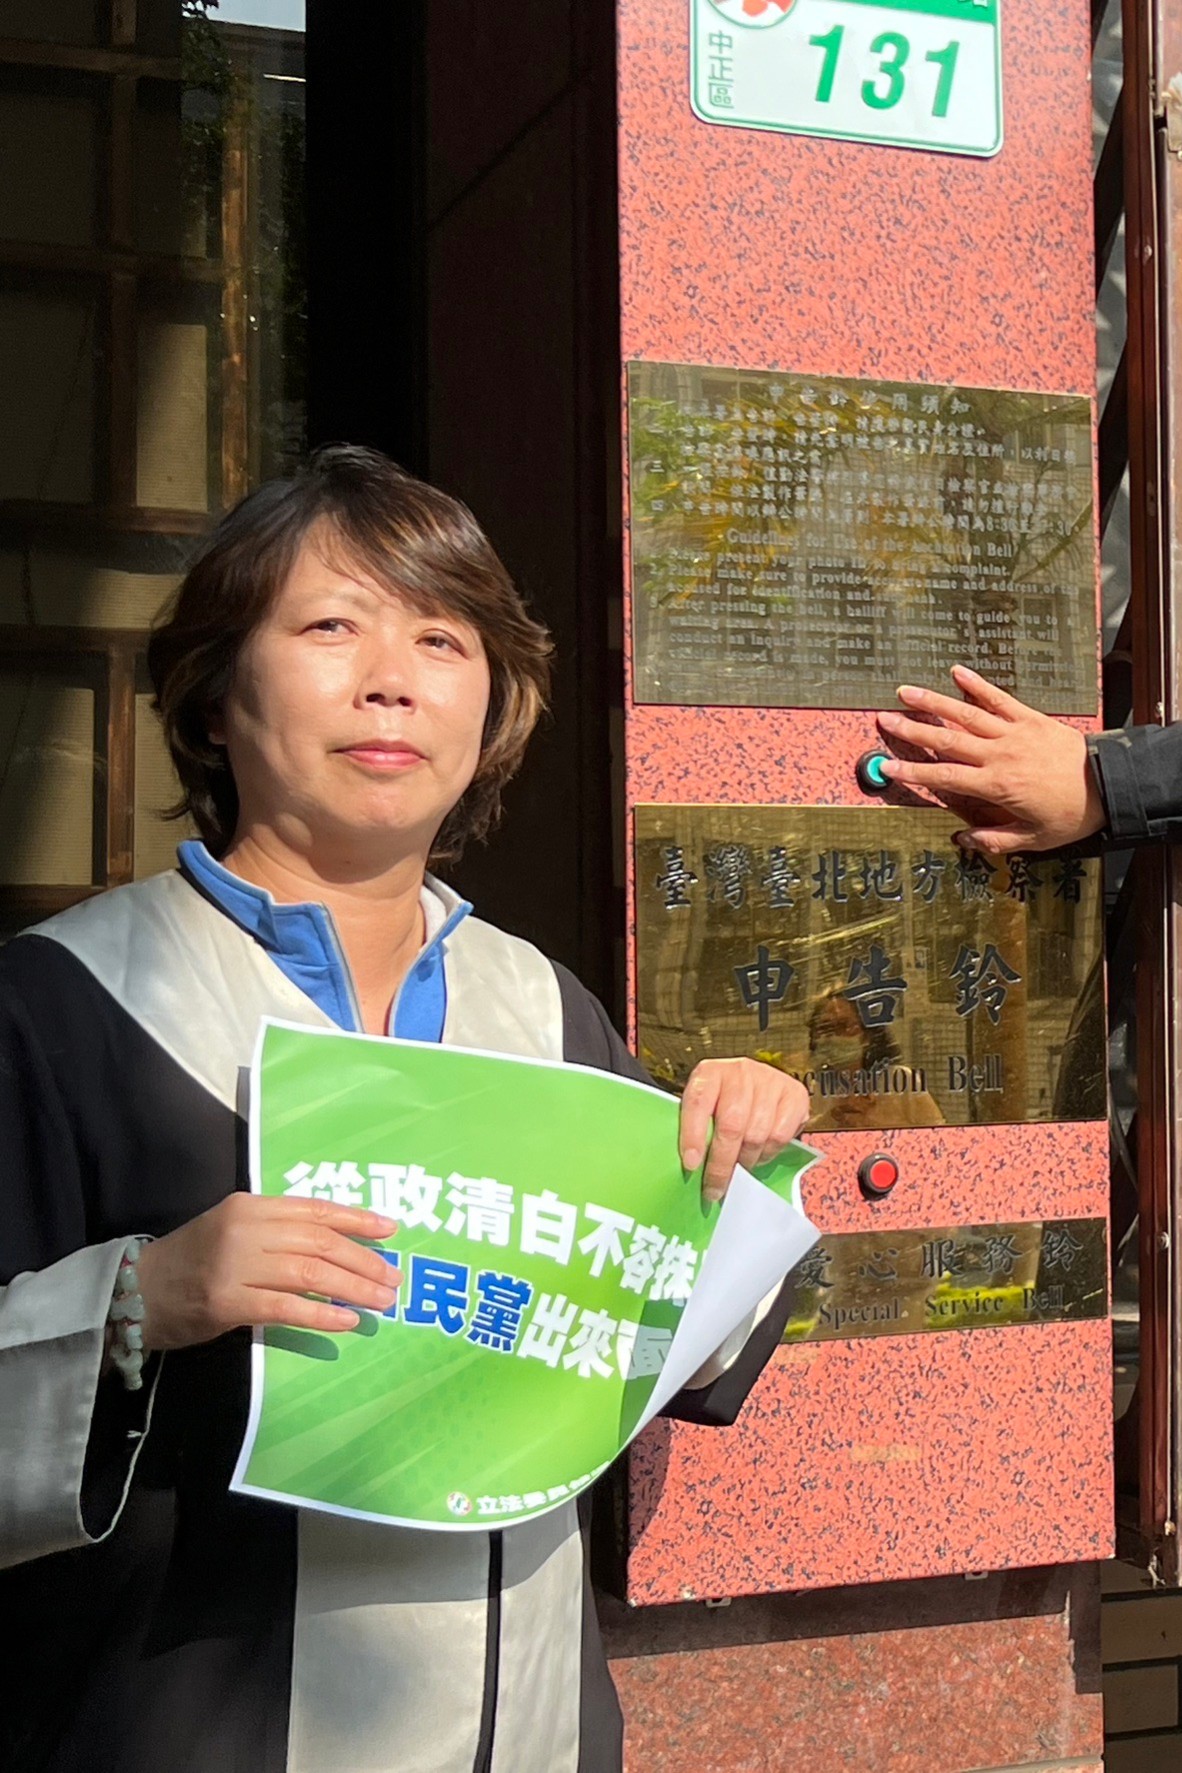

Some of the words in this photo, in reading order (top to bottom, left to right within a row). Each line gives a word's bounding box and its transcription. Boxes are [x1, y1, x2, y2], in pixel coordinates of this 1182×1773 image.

[707, 30, 735, 110] 中正區
[808, 24, 960, 118] 131
[716, 551, 767, 568] present
[770, 554, 802, 569] your
[807, 554, 845, 571] photo
[726, 527, 800, 549] Guidelines
[805, 531, 826, 547] for
[832, 533, 857, 549] Use
[863, 534, 878, 550] of
[881, 535, 905, 551] the
[986, 542, 1012, 558] Bell
[667, 563, 711, 577] Please
[716, 565, 753, 580] make
[757, 569, 787, 581] sure
[792, 569, 806, 582] to
[811, 570, 861, 587] provide
[962, 577, 987, 591] and
[990, 578, 1038, 594] address
[726, 581, 747, 596] for
[845, 587, 870, 601] and
[710, 597, 766, 616] pressing
[771, 600, 793, 614] the
[919, 609, 953, 621] come
[957, 609, 970, 621] to
[975, 609, 1010, 626] guide
[1045, 613, 1058, 625] to
[668, 630, 723, 644] conduct
[728, 634, 746, 645] an
[836, 636, 871, 649] make
[876, 639, 892, 650] an
[655, 845, 1088, 910] 臺灣臺北地方檢察署
[733, 943, 1022, 1032] 申告鈴
[948, 1055, 1004, 1095] Bell
[283, 1160, 702, 1307] 從政清白不容抹
[794, 1228, 1083, 1289] 愛心服務鈴
[328, 1246, 674, 1381] 民黨出來面
[818, 1298, 900, 1328] Special
[925, 1290, 1004, 1316] Service
[1022, 1283, 1066, 1312] Bell
